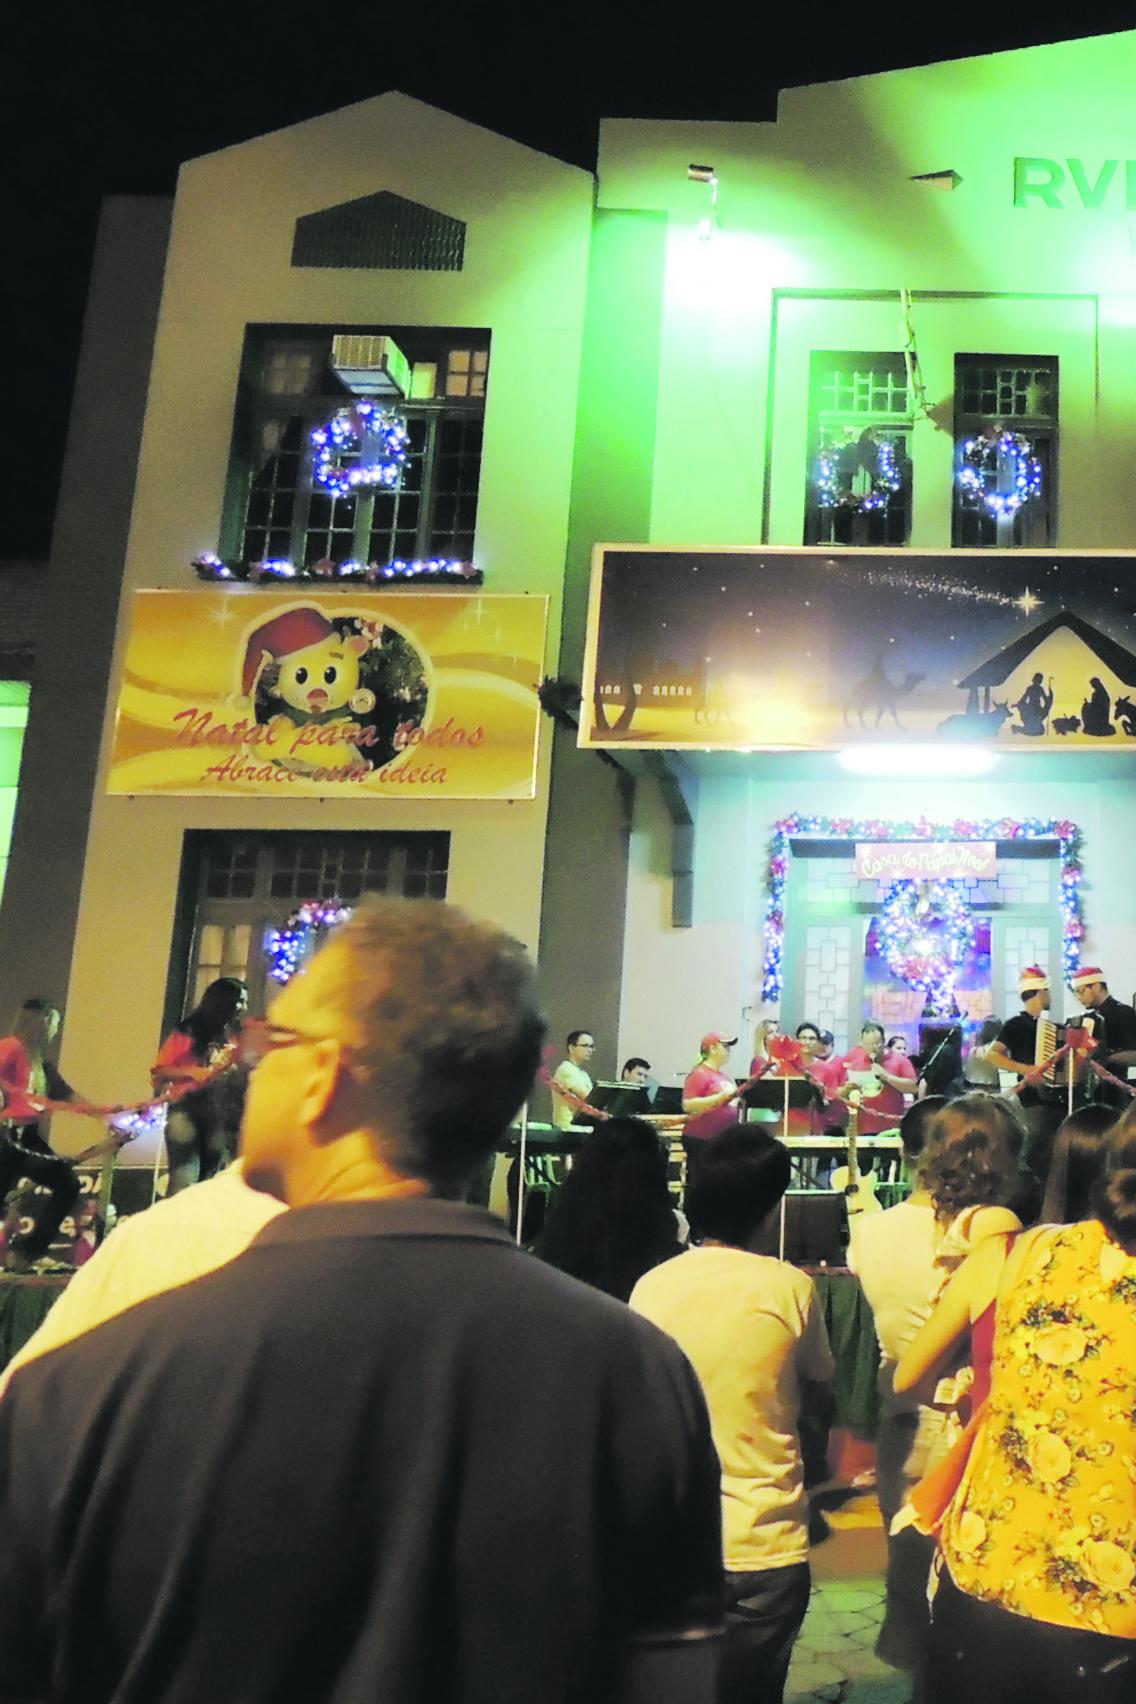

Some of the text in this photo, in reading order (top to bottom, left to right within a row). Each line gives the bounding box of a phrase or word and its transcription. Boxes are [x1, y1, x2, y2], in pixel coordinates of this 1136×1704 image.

[173, 708, 485, 753] Natal para todos
[200, 755, 299, 783] Abrace
[379, 763, 448, 784] ideia
